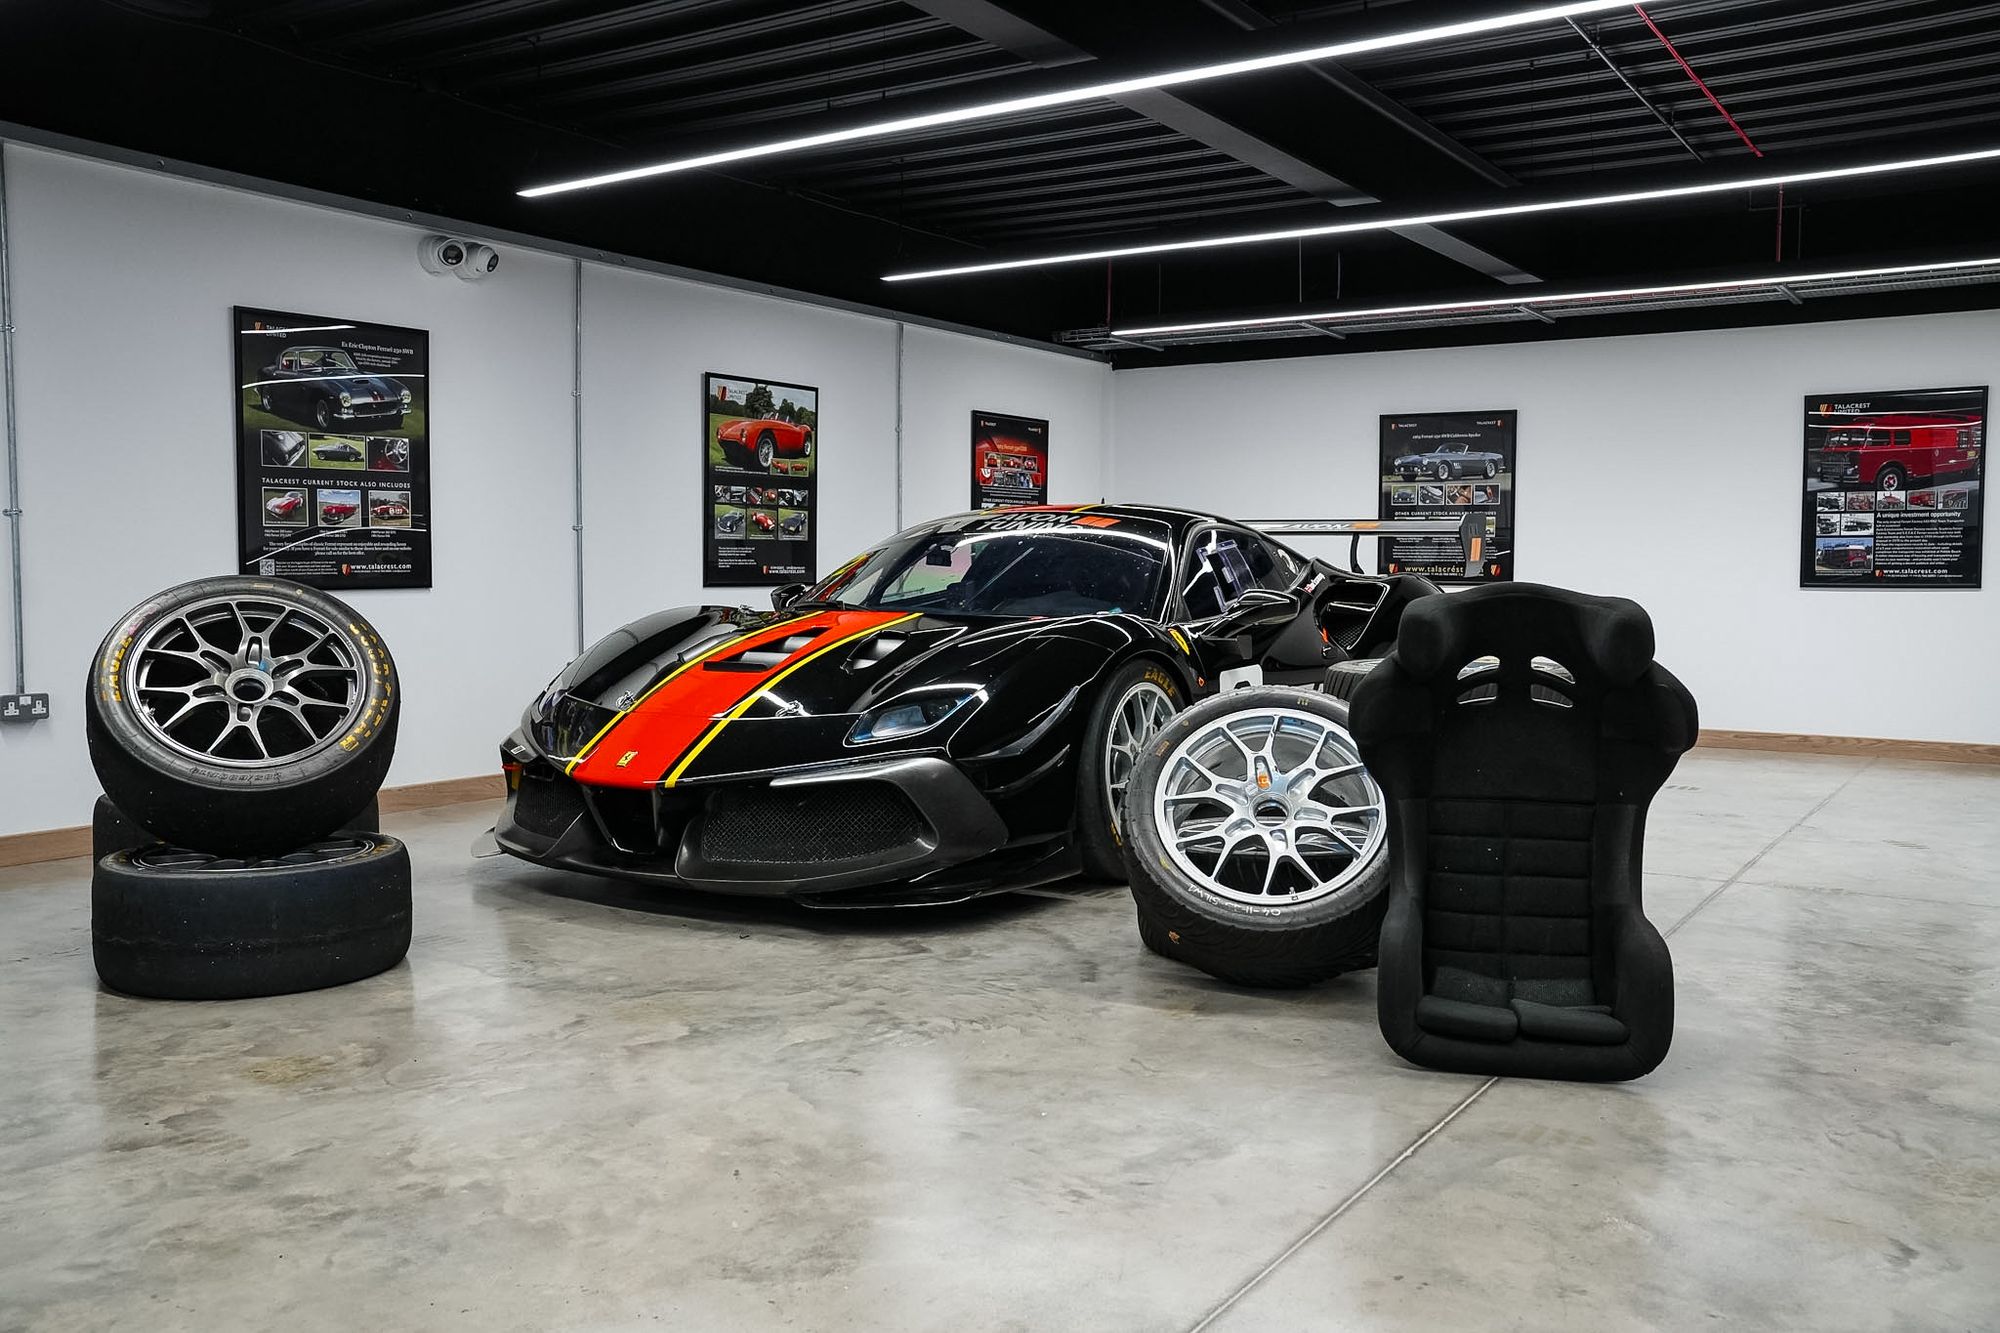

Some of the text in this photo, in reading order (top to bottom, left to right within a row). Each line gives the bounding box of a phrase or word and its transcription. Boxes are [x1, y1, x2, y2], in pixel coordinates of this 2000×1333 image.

[261, 477, 300, 485] TALACREST
[991, 513, 1081, 523] AVON
[1405, 565, 1464, 573] www.talacrest
[1143, 670, 1176, 698] EAGLE
